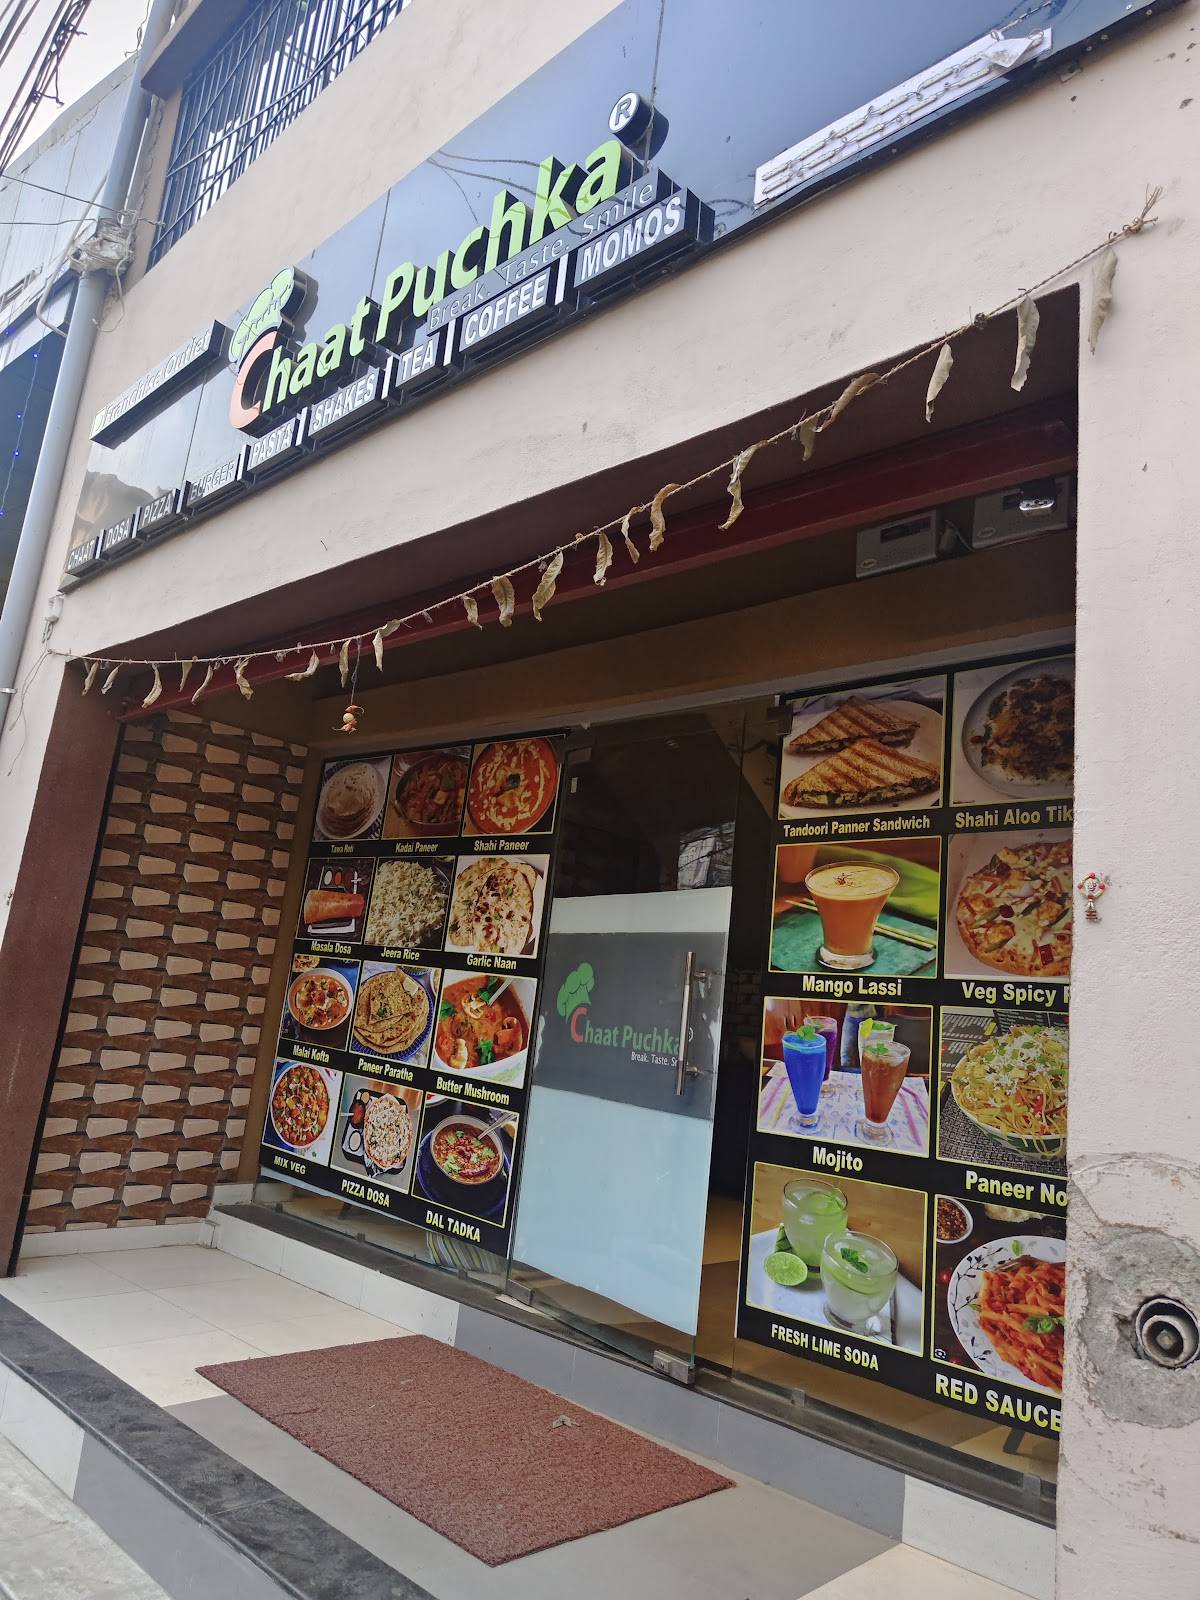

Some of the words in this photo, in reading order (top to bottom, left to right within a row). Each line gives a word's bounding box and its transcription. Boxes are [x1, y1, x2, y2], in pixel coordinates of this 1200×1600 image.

[429, 281, 491, 327] Break.
[501, 240, 570, 286] Taste.
[581, 184, 653, 241] Smile
[142, 495, 174, 526] PIZZA
[190, 461, 236, 500] BURGER
[251, 423, 293, 465] PASTA
[312, 373, 376, 430] SHAKES
[400, 340, 436, 382] TEA
[464, 274, 548, 346] COFFEE
[581, 197, 683, 281] MOMOS
[784, 820, 828, 837] Tandoori
[831, 819, 870, 834] Panner
[873, 816, 931, 832] Sandwich
[955, 810, 999, 829] Shahi
[1004, 808, 1041, 826] Aloo
[396, 842, 413, 853] Kadai
[414, 842, 439, 853] Paneer
[474, 840, 498, 852] Shahi
[499, 840, 530, 851] Paneer
[311, 940, 333, 953] Masala
[335, 942, 352, 954] Dosa
[381, 948, 401, 959] Jeera
[403, 949, 420, 960] Rice
[467, 954, 492, 967] Garlic
[494, 957, 517, 970] Naan
[802, 975, 854, 995] Mango
[858, 979, 902, 996] Lassi
[961, 982, 997, 1004] Veg
[1003, 983, 1057, 1007] Spicy
[570, 1007, 618, 1047] Chaat
[311, 1047, 330, 1063] Kofta
[651, 1053, 669, 1066] Taste.
[358, 1058, 383, 1076] Paneer
[385, 1062, 413, 1082] Paratha
[437, 1077, 463, 1095] Butter
[465, 1083, 510, 1105] Mushroom
[274, 1156, 288, 1168] MIX
[290, 1161, 306, 1175] VEG
[812, 1146, 863, 1173] Mojito
[342, 1179, 365, 1200] PIZZA
[367, 1187, 390, 1208] DOSA
[966, 1170, 1035, 1200] Paneer
[1040, 1182, 1068, 1207] No
[426, 1210, 445, 1229] DAL
[447, 1214, 481, 1243] TADKA
[771, 1324, 809, 1350] FRESH
[812, 1336, 841, 1360] LIME
[845, 1347, 879, 1371] SODA
[935, 1373, 978, 1405] RED
[985, 1389, 1062, 1433] SAUCE
